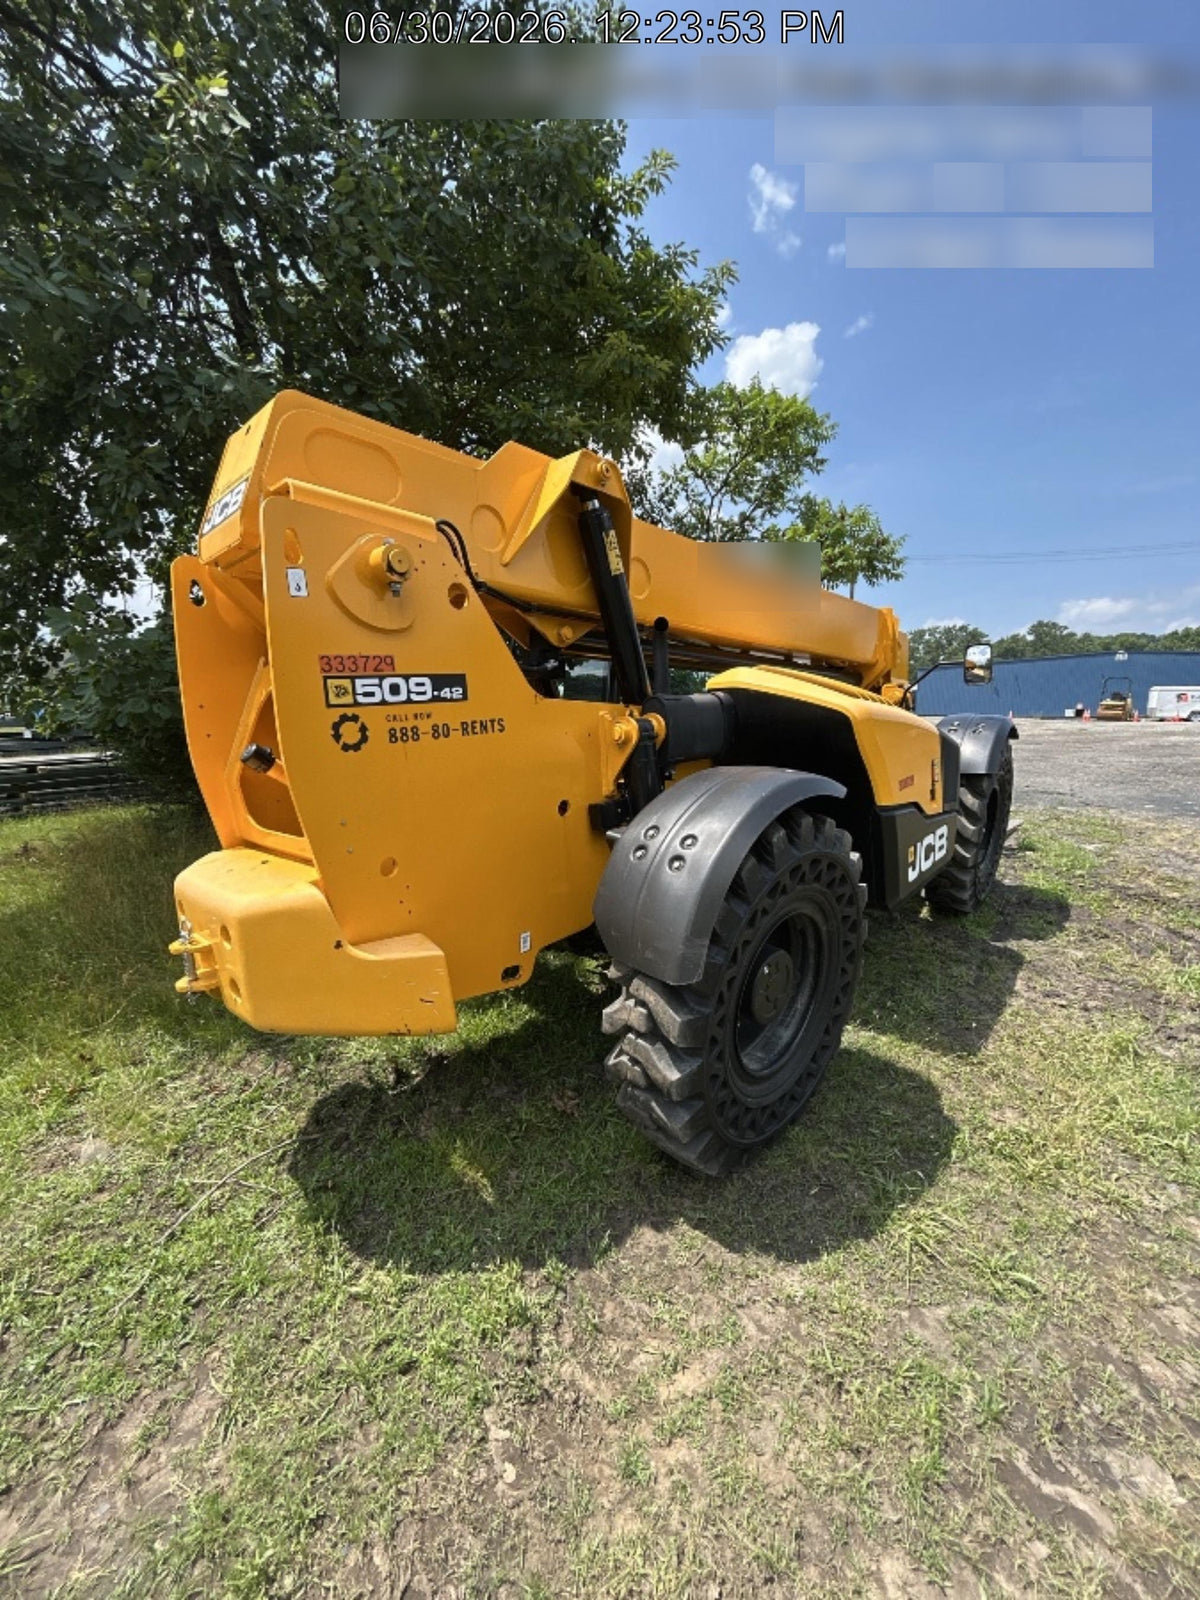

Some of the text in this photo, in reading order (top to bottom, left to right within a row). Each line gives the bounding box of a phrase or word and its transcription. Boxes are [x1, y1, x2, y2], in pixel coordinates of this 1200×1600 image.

[320, 655, 395, 673] 333729
[388, 718, 506, 744] 888-80-RENTS
[908, 824, 948, 882] JCB
